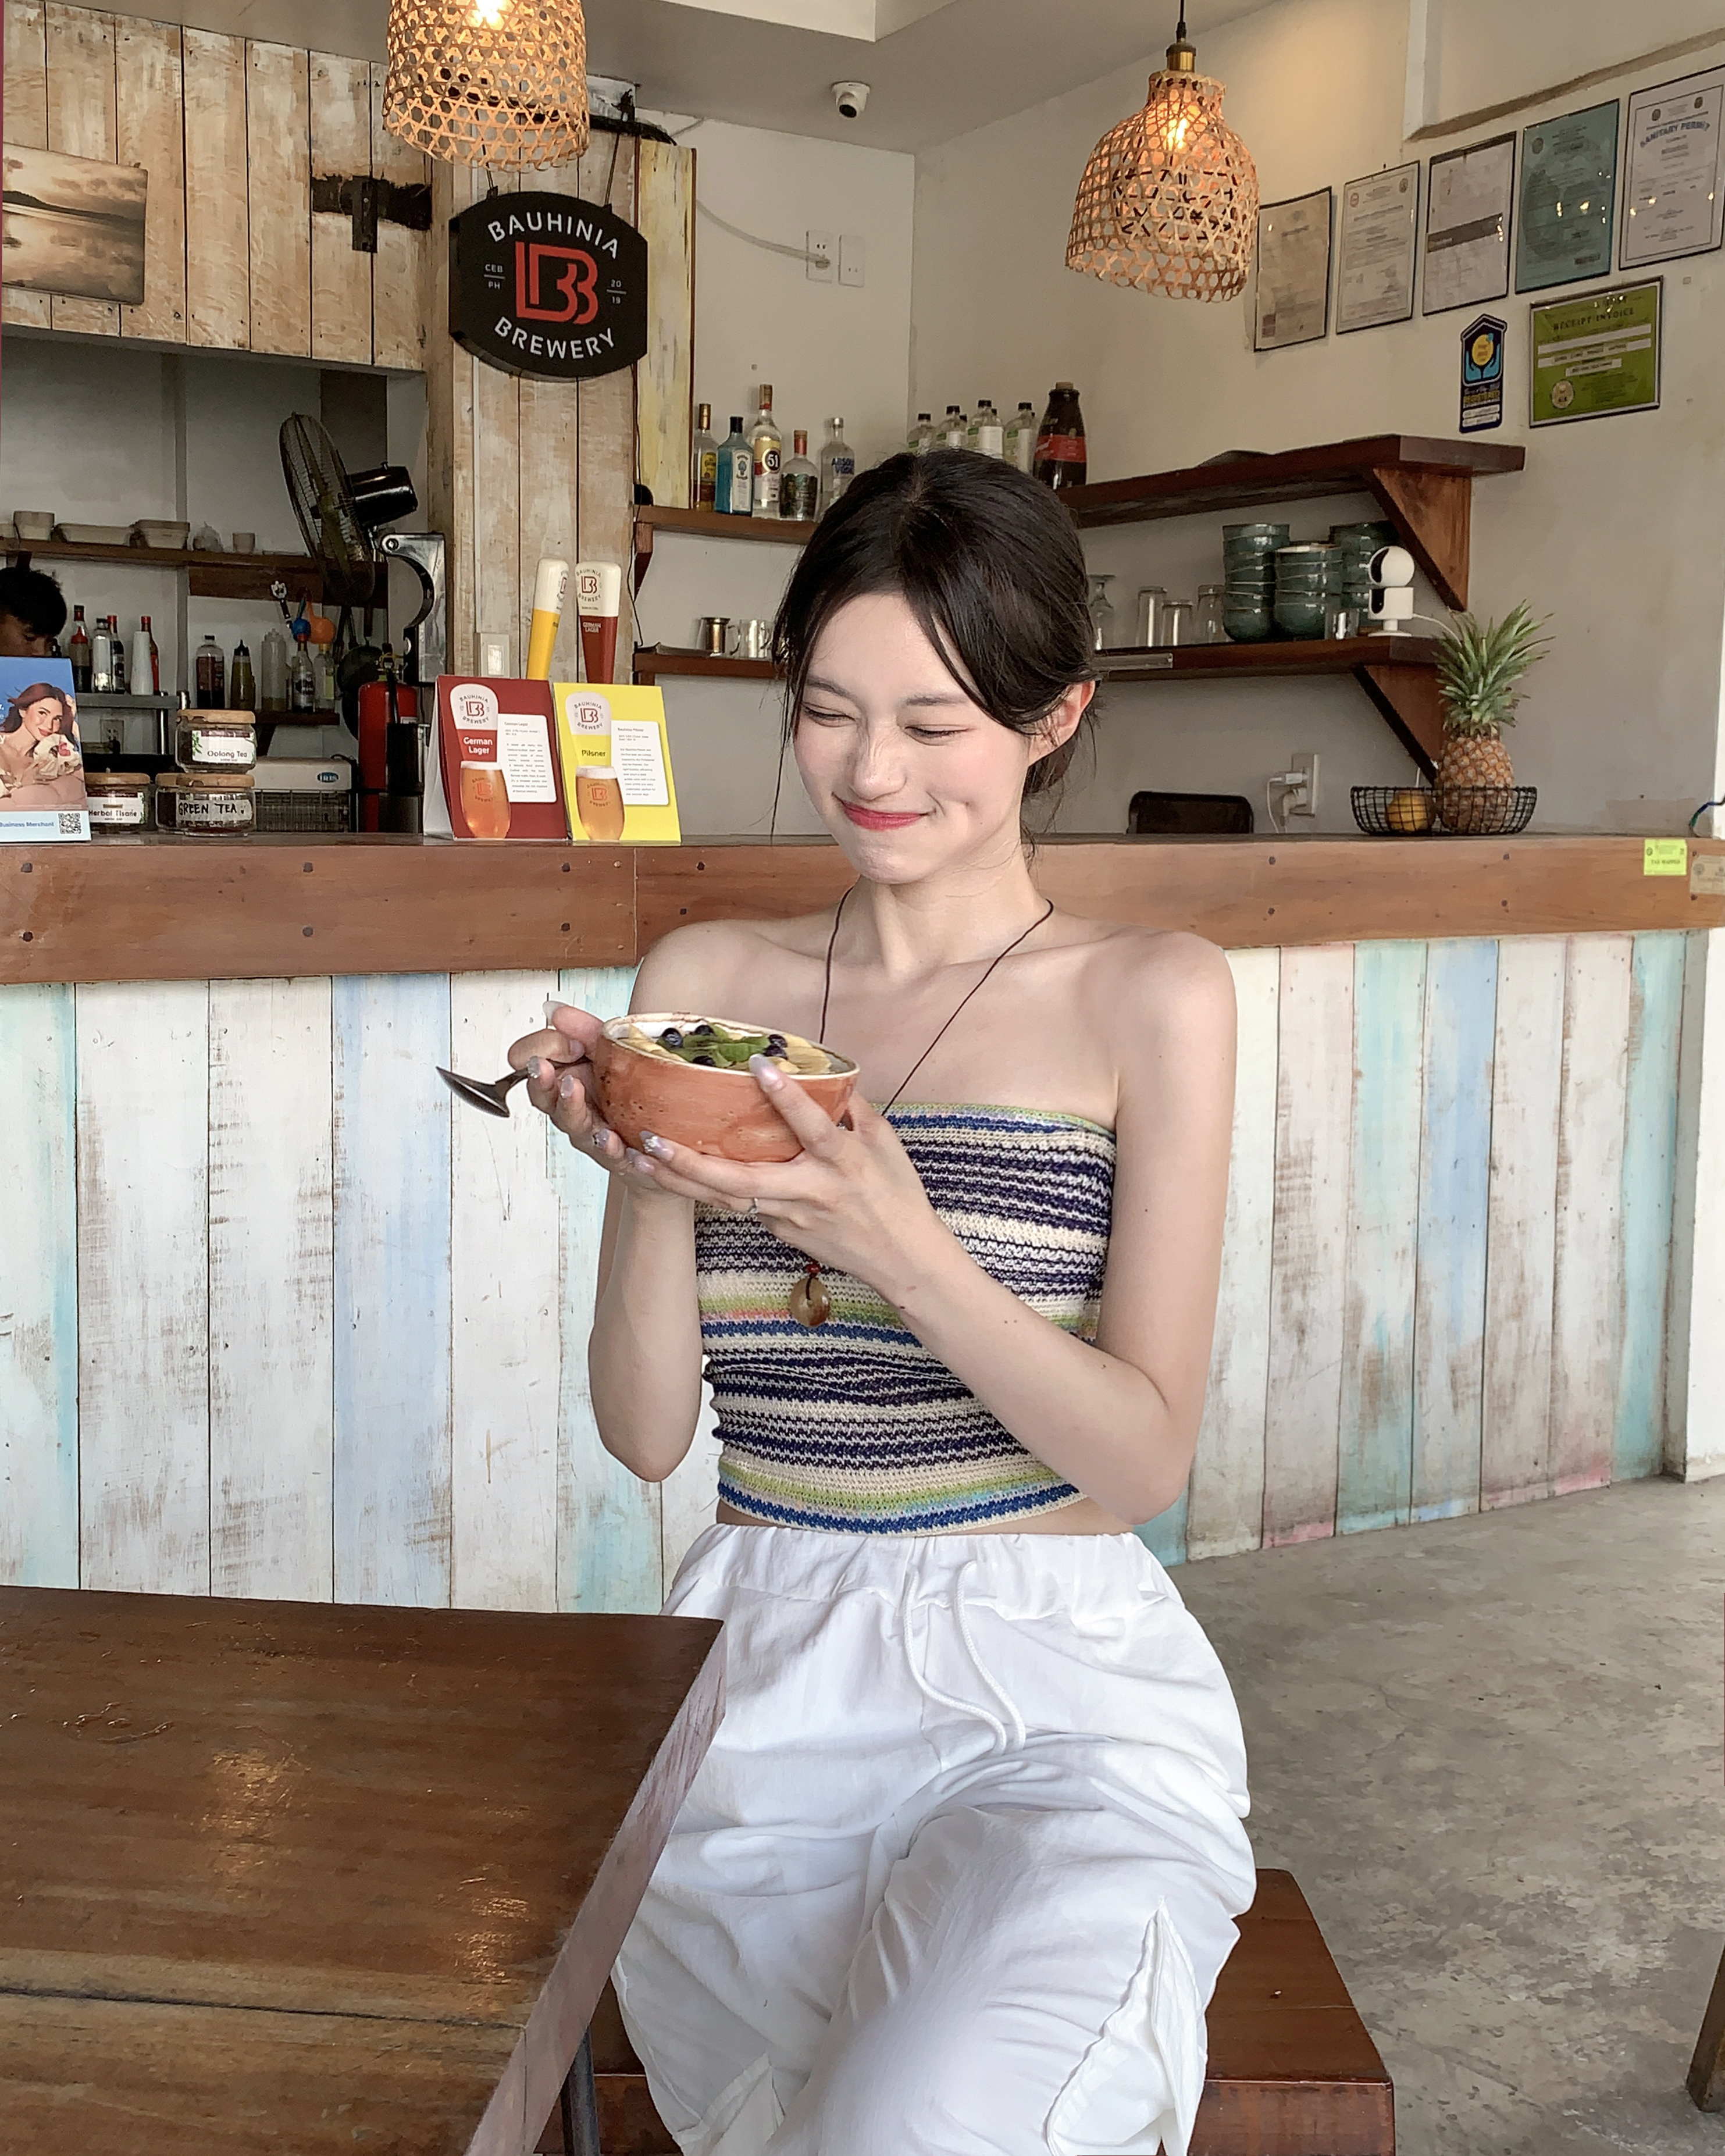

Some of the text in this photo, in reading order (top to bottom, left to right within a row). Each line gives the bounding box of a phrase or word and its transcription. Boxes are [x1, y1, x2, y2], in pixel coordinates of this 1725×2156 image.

[487, 212, 618, 259] BAUHINIA
[484, 264, 503, 273] CEB
[488, 281, 500, 290] PH
[611, 279, 622, 288] 20
[612, 296, 621, 304] 19
[494, 316, 614, 359] BREWERY
[768, 454, 779, 468] 51
[459, 694, 488, 703] BAUHINIA
[573, 701, 602, 710] BAUHINIA
[462, 715, 489, 724] BREWERY
[463, 737, 493, 746] German
[207, 750, 235, 758] Oolong
[468, 746, 490, 756] Lager
[179, 802, 237, 815] GREEN TEA
